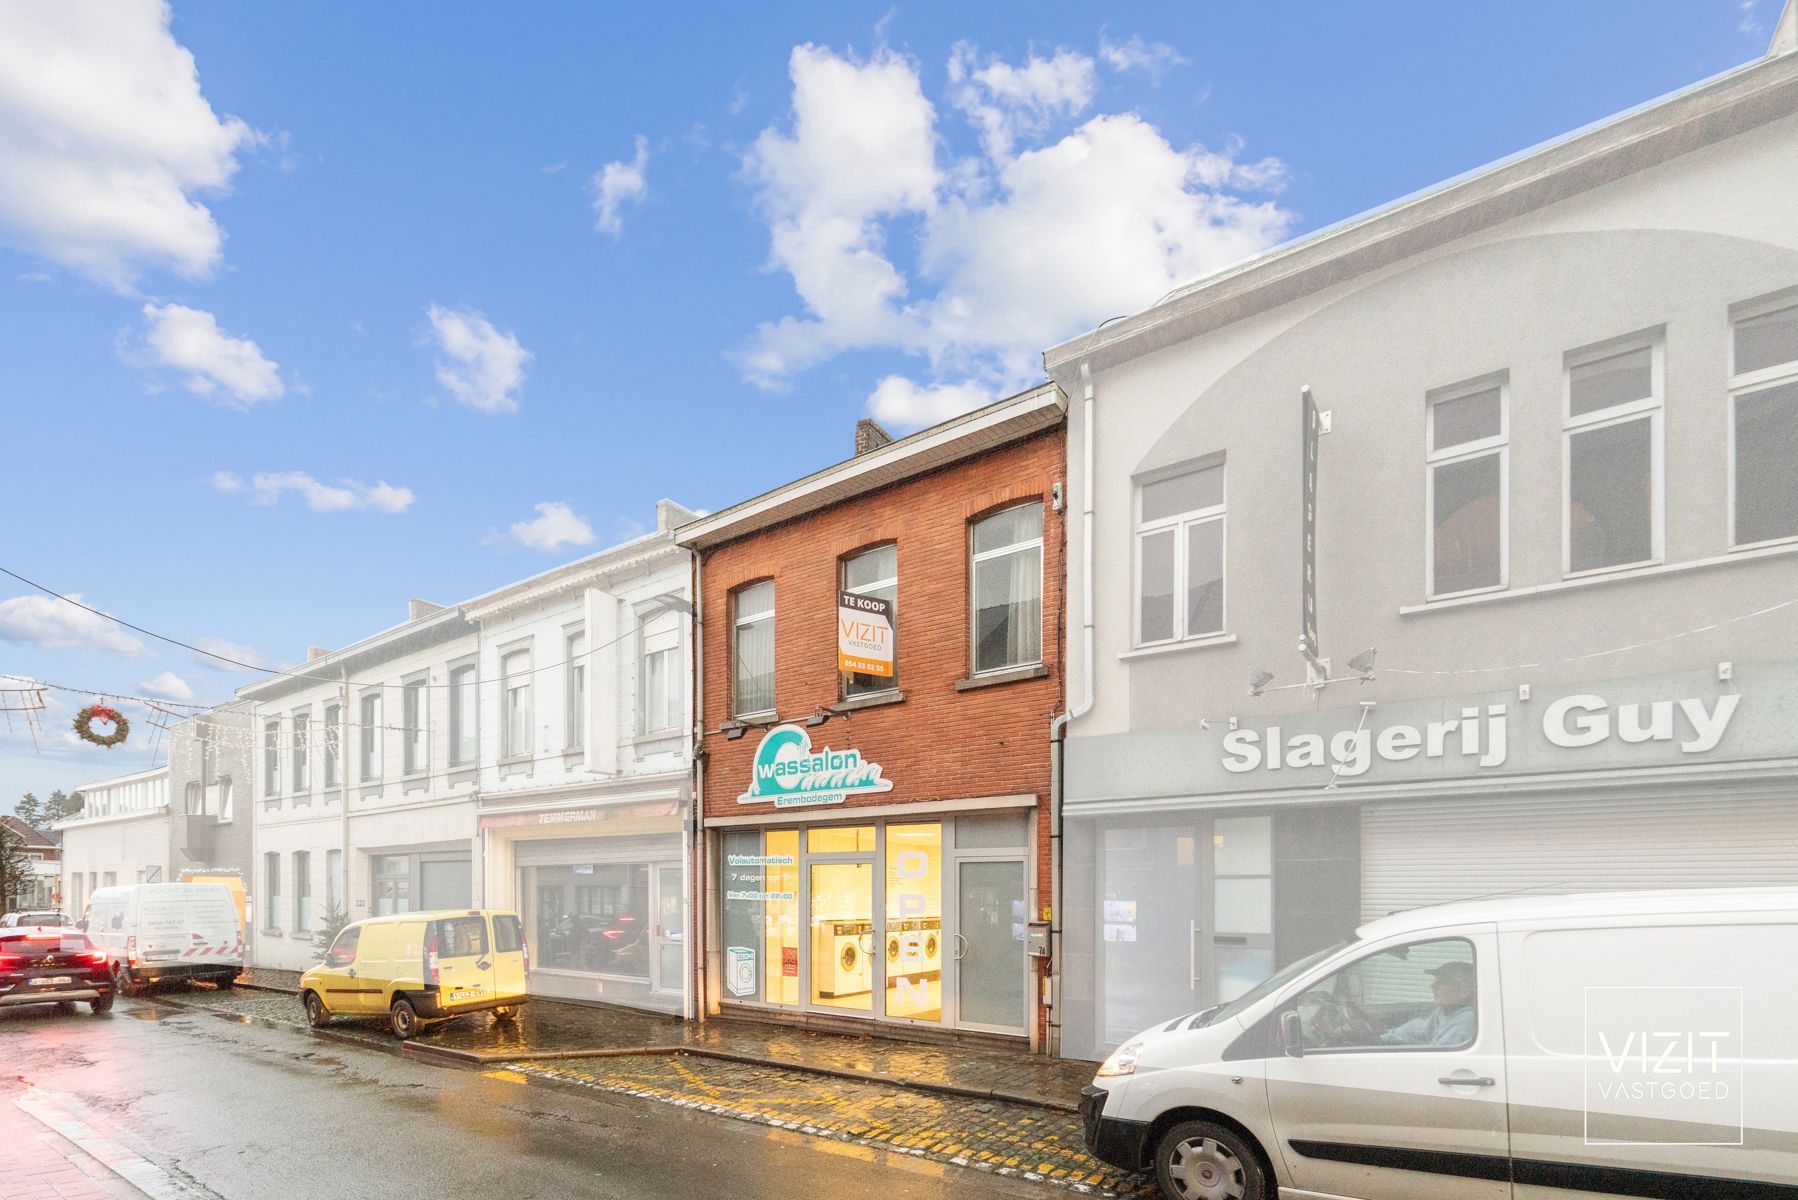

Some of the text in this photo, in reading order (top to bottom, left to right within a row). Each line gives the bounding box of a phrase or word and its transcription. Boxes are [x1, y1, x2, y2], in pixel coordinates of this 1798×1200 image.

[844, 596, 885, 611] TE KOOP
[842, 619, 888, 643] VIZIT
[848, 640, 882, 650] VASTGOED
[1221, 694, 1742, 776] Slagerij Guy
[758, 750, 858, 779] wassalon
[777, 792, 843, 806] Erembodegem
[538, 809, 596, 824] TEMMERMAN
[728, 855, 793, 865] Volautomatisch
[731, 873, 738, 881] 7
[739, 873, 765, 883] dagen
[897, 851, 928, 1004] OPEN
